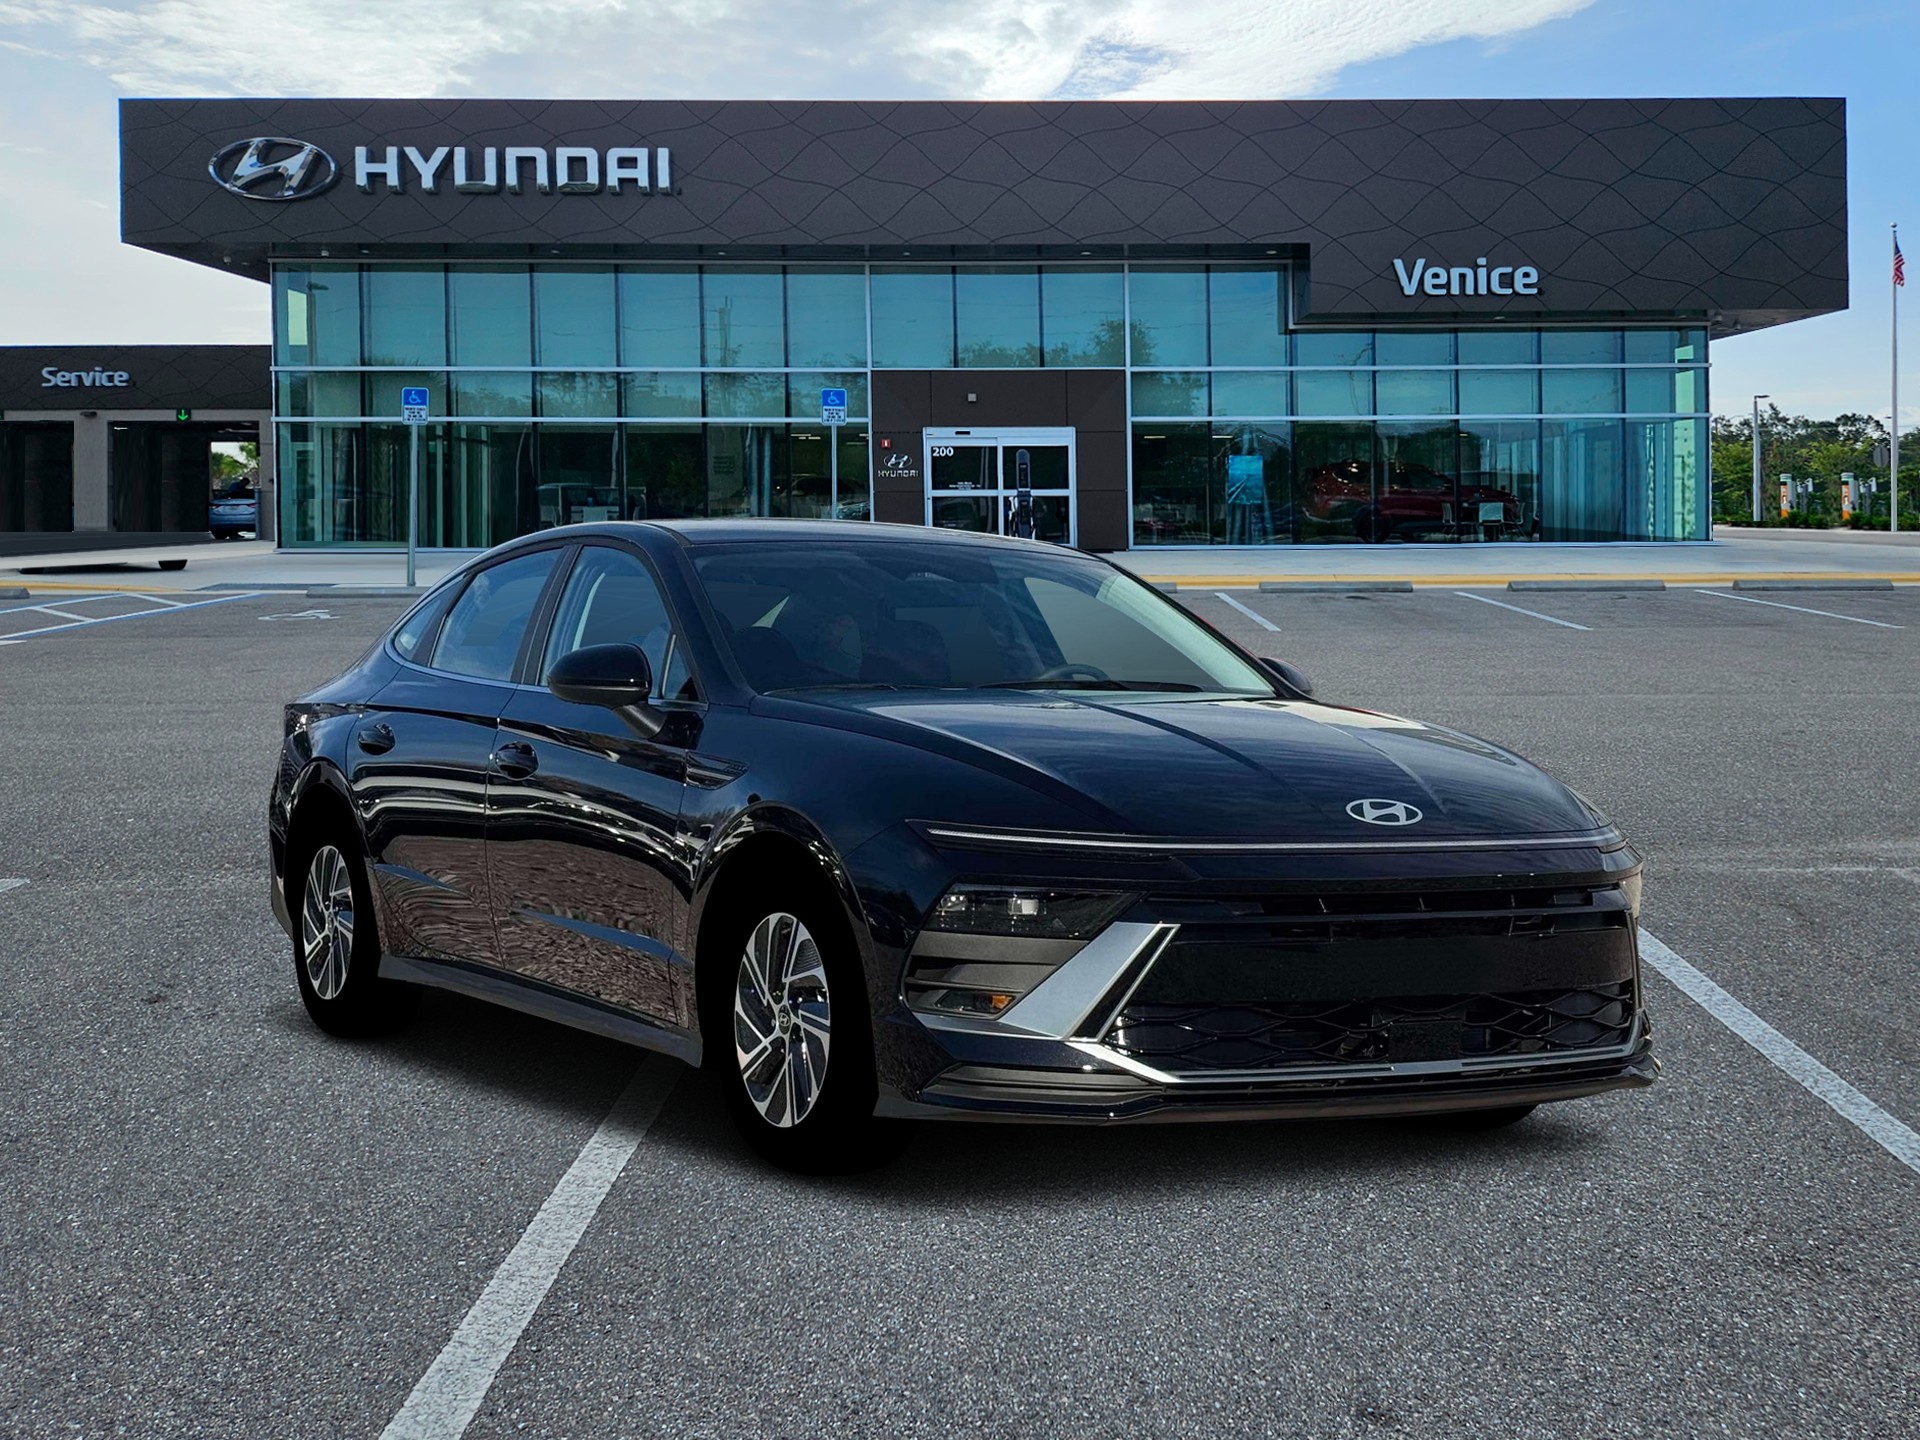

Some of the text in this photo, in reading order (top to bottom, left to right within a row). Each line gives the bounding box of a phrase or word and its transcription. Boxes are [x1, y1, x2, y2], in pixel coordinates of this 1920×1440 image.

[355, 146, 670, 193] HYUNDAI
[1393, 257, 1539, 295] Venice
[41, 366, 129, 387] Service
[932, 446, 954, 457] 200
[877, 470, 919, 478] HYUNDAI
